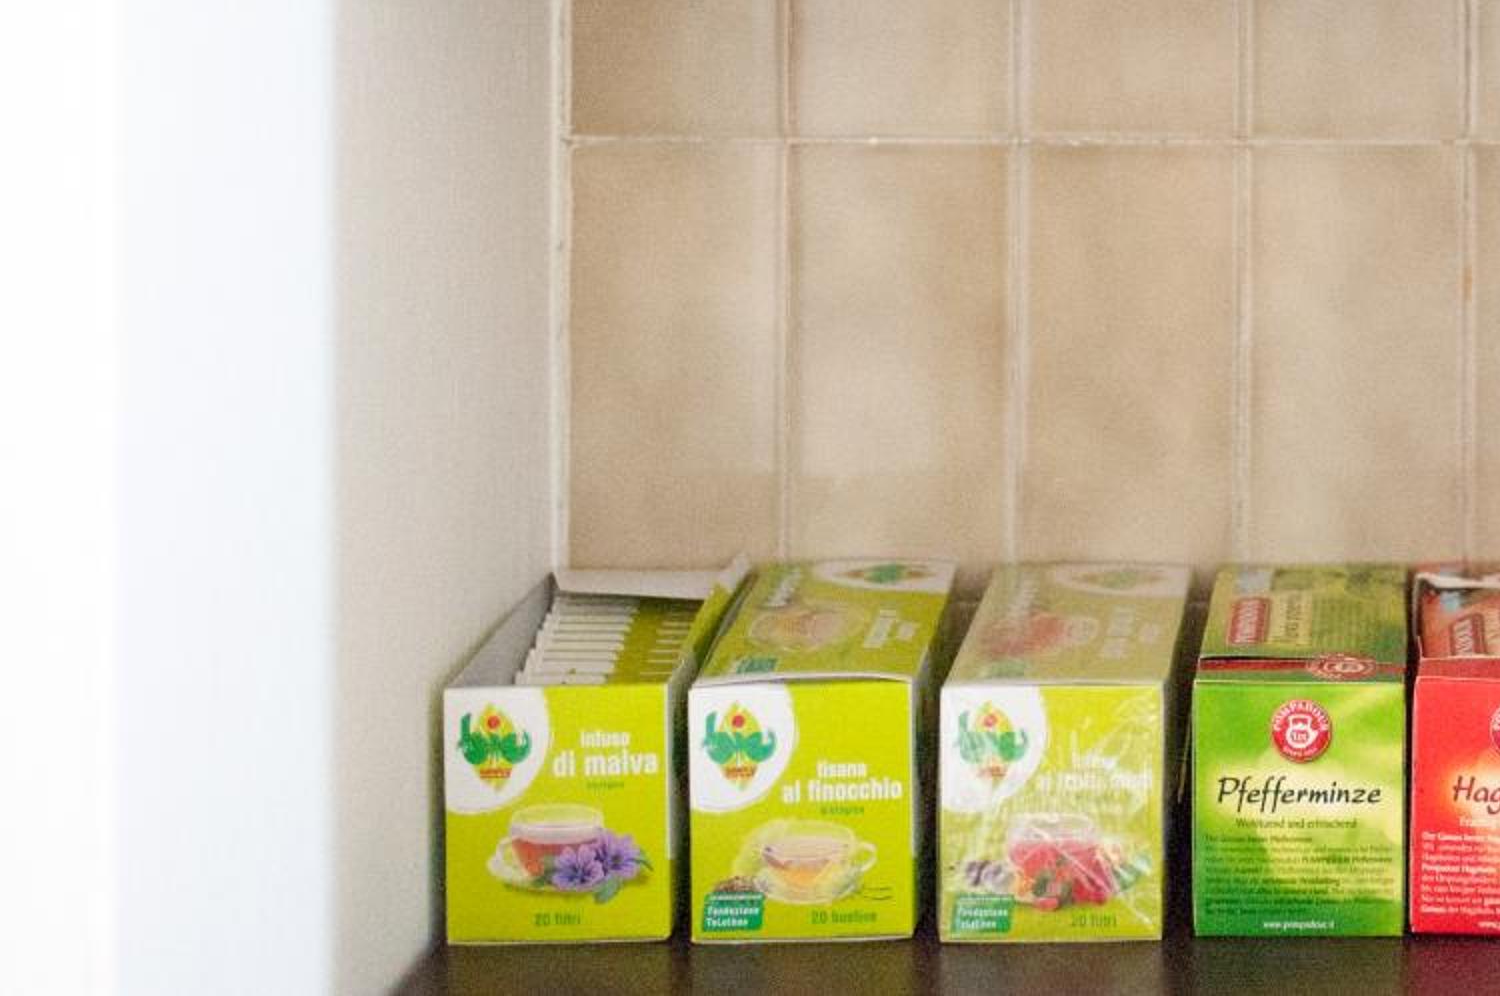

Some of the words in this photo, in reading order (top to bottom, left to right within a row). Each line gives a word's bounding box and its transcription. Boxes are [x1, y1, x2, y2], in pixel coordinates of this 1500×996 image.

[553, 750, 576, 777] di
[584, 750, 659, 775] malva
[817, 761, 867, 778] tisana
[782, 781, 801, 803] al
[808, 778, 903, 802] finocchio
[1218, 776, 1383, 813] Pfefferminze
[535, 912, 550, 926] 20
[811, 909, 829, 925] 20
